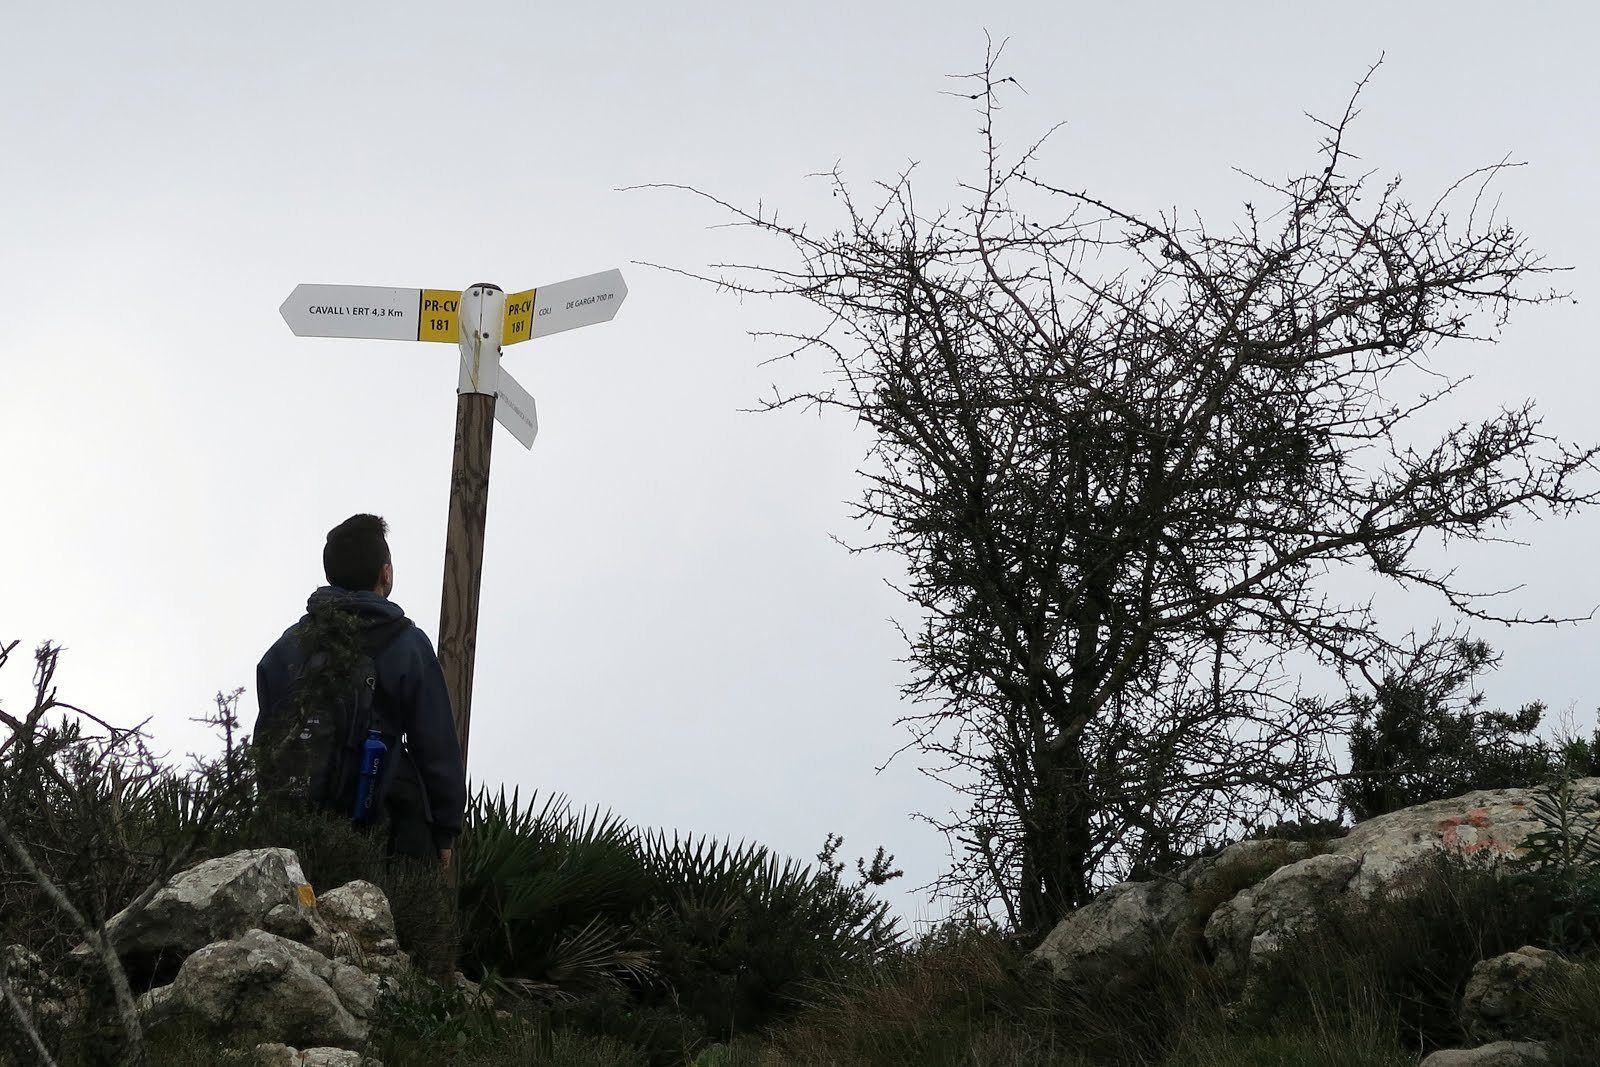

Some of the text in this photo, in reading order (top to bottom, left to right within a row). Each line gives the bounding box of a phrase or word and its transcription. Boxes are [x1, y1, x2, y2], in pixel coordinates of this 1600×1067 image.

[424, 300, 458, 312] PR-CV
[508, 300, 532, 316] PR-CV
[566, 301, 574, 310] DE
[575, 296, 596, 307] GARGA
[596, 293, 607, 303] 700
[309, 305, 345, 315] CAVALL
[371, 308, 386, 318] 4,3
[387, 309, 403, 317] Km
[430, 320, 449, 331] 181
[511, 320, 525, 333] 181
